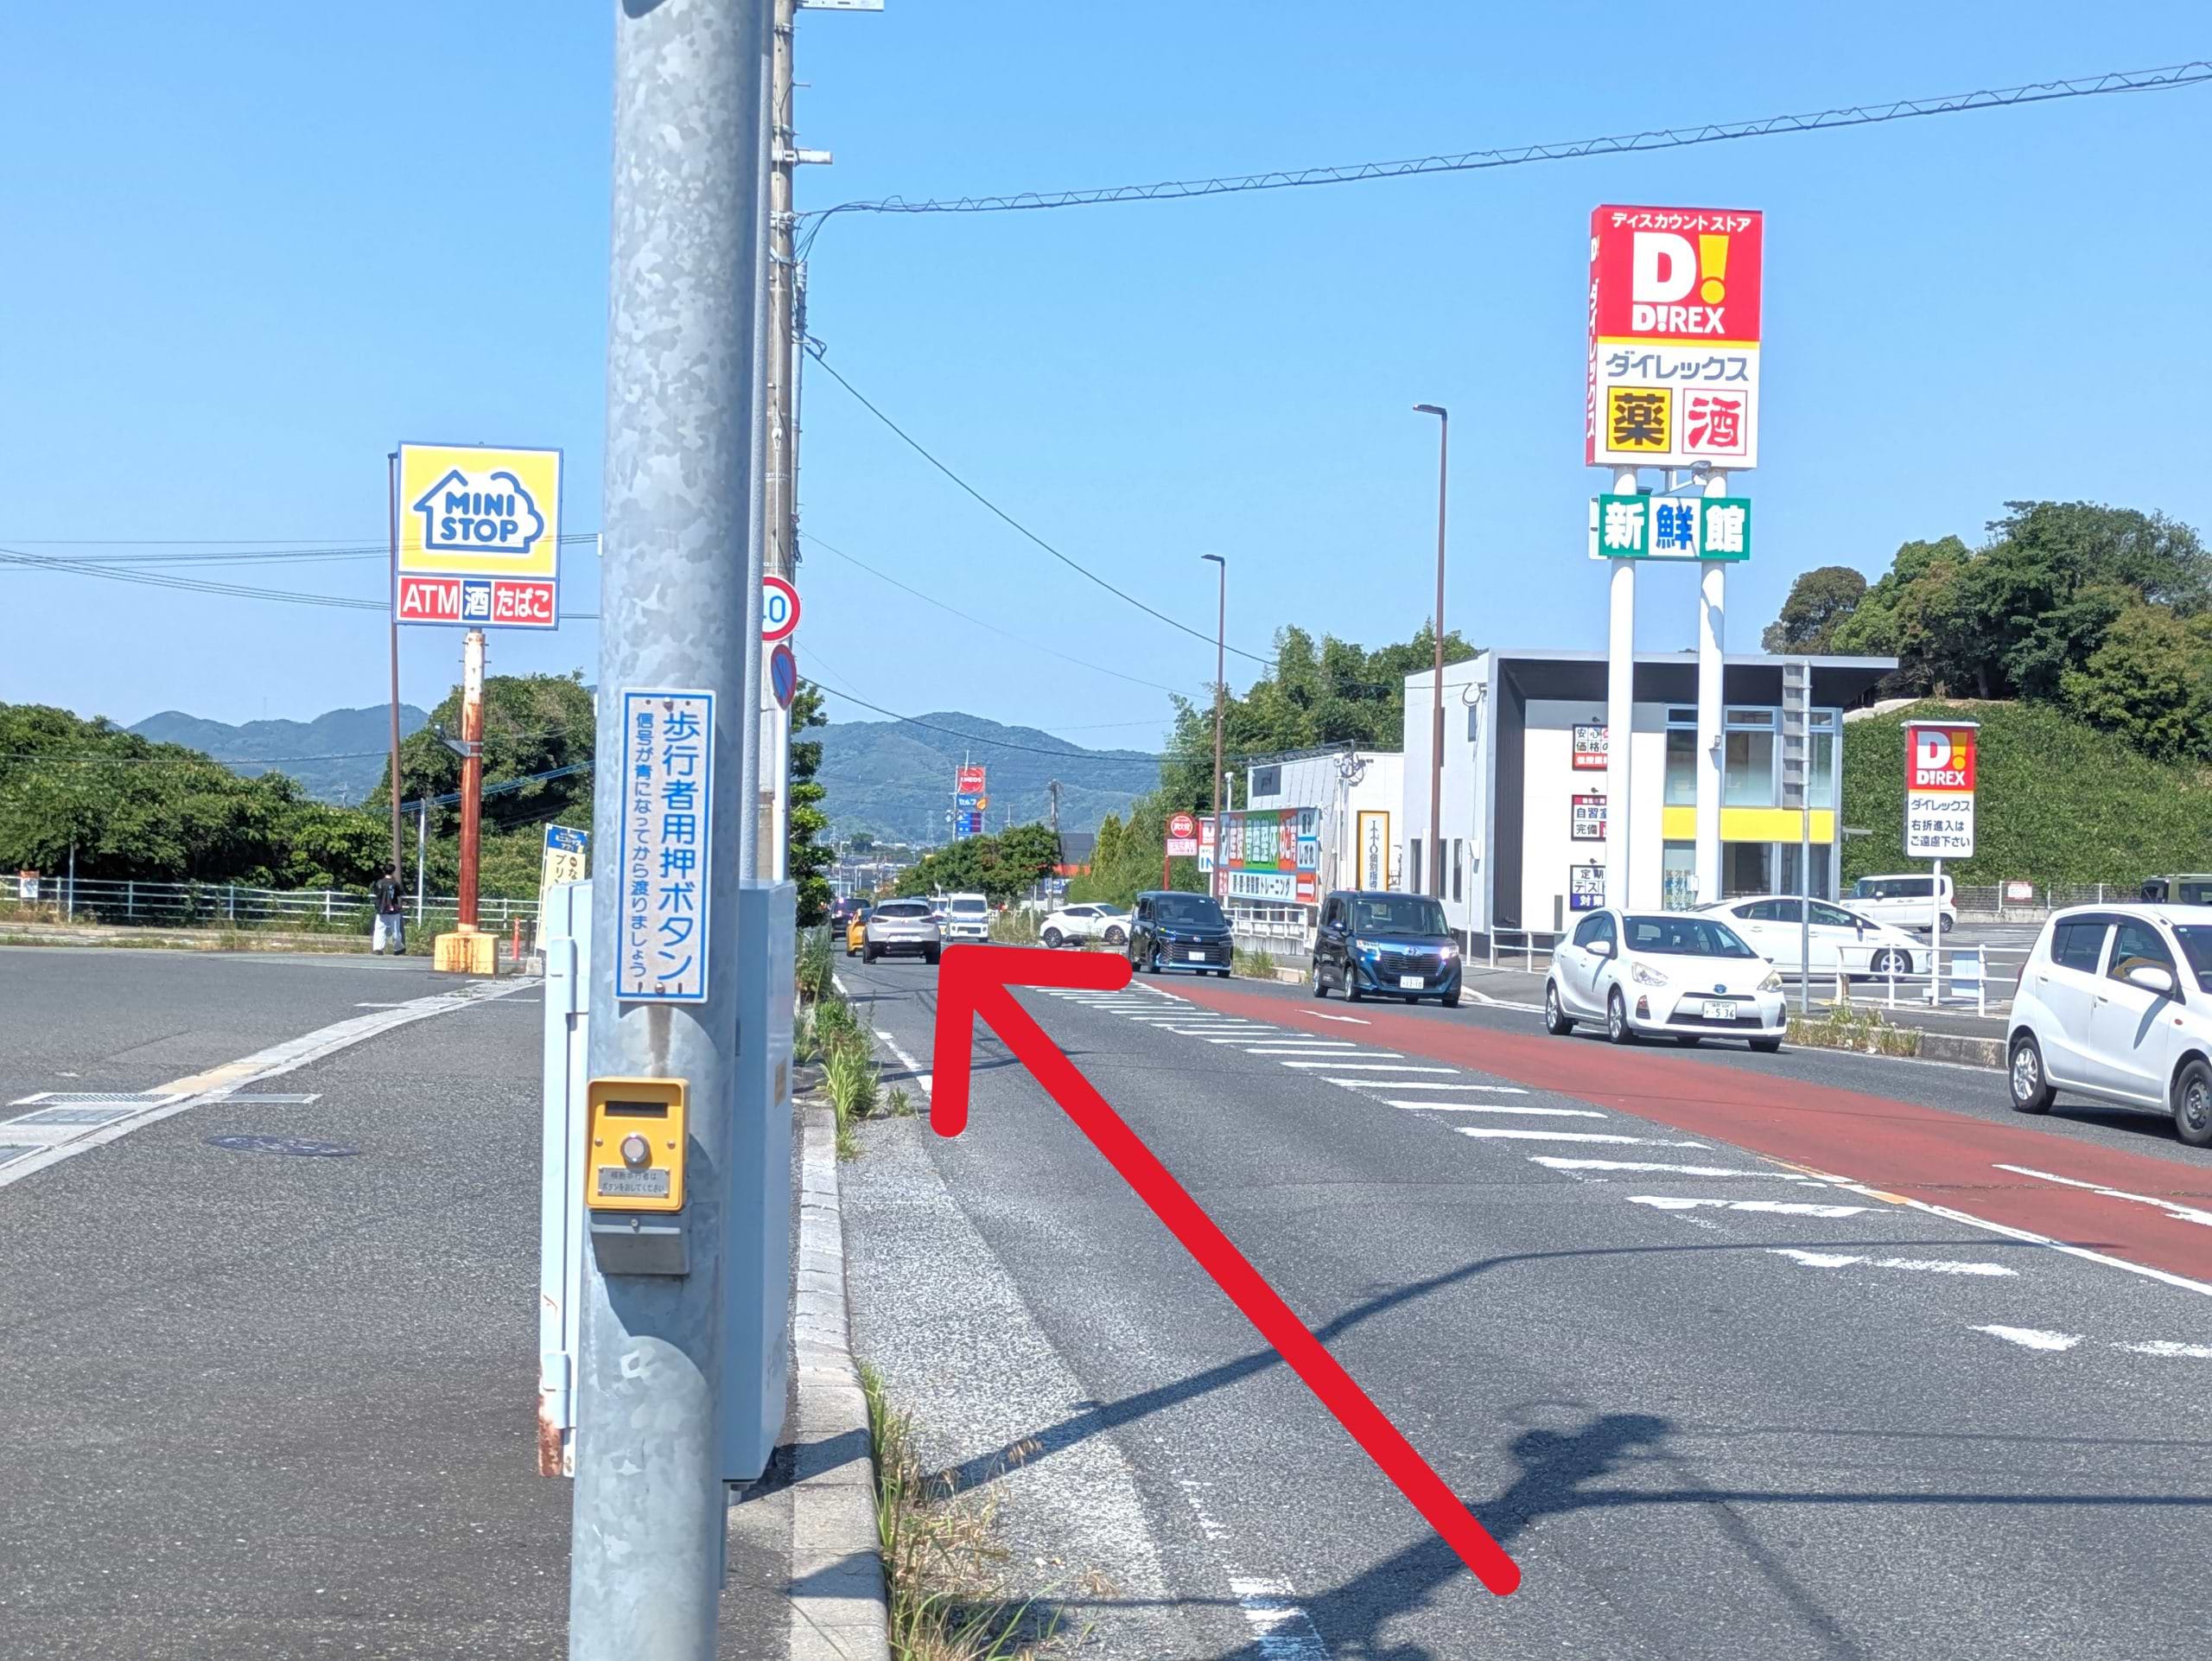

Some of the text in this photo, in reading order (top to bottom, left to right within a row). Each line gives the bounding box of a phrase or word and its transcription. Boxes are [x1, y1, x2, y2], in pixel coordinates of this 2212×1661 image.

[1611, 213, 1751, 232] ディスカウントストア
[1605, 350, 1749, 381] ダイレックス
[1613, 393, 1741, 449] 薬 酒
[445, 491, 515, 517] MINI
[441, 517, 518, 543] STOP
[1604, 502, 1745, 552] 新鮮館
[403, 584, 550, 618] ATM 酒 たばこ
[1910, 799, 1970, 811] ダイレックス
[1911, 820, 1964, 831] 右折進入は
[629, 712, 654, 978] 信号が青になってから渡りましょう
[657, 710, 701, 980] 歩行者用押ボタン
[1910, 836, 1970, 847] ご遠慮下さい
